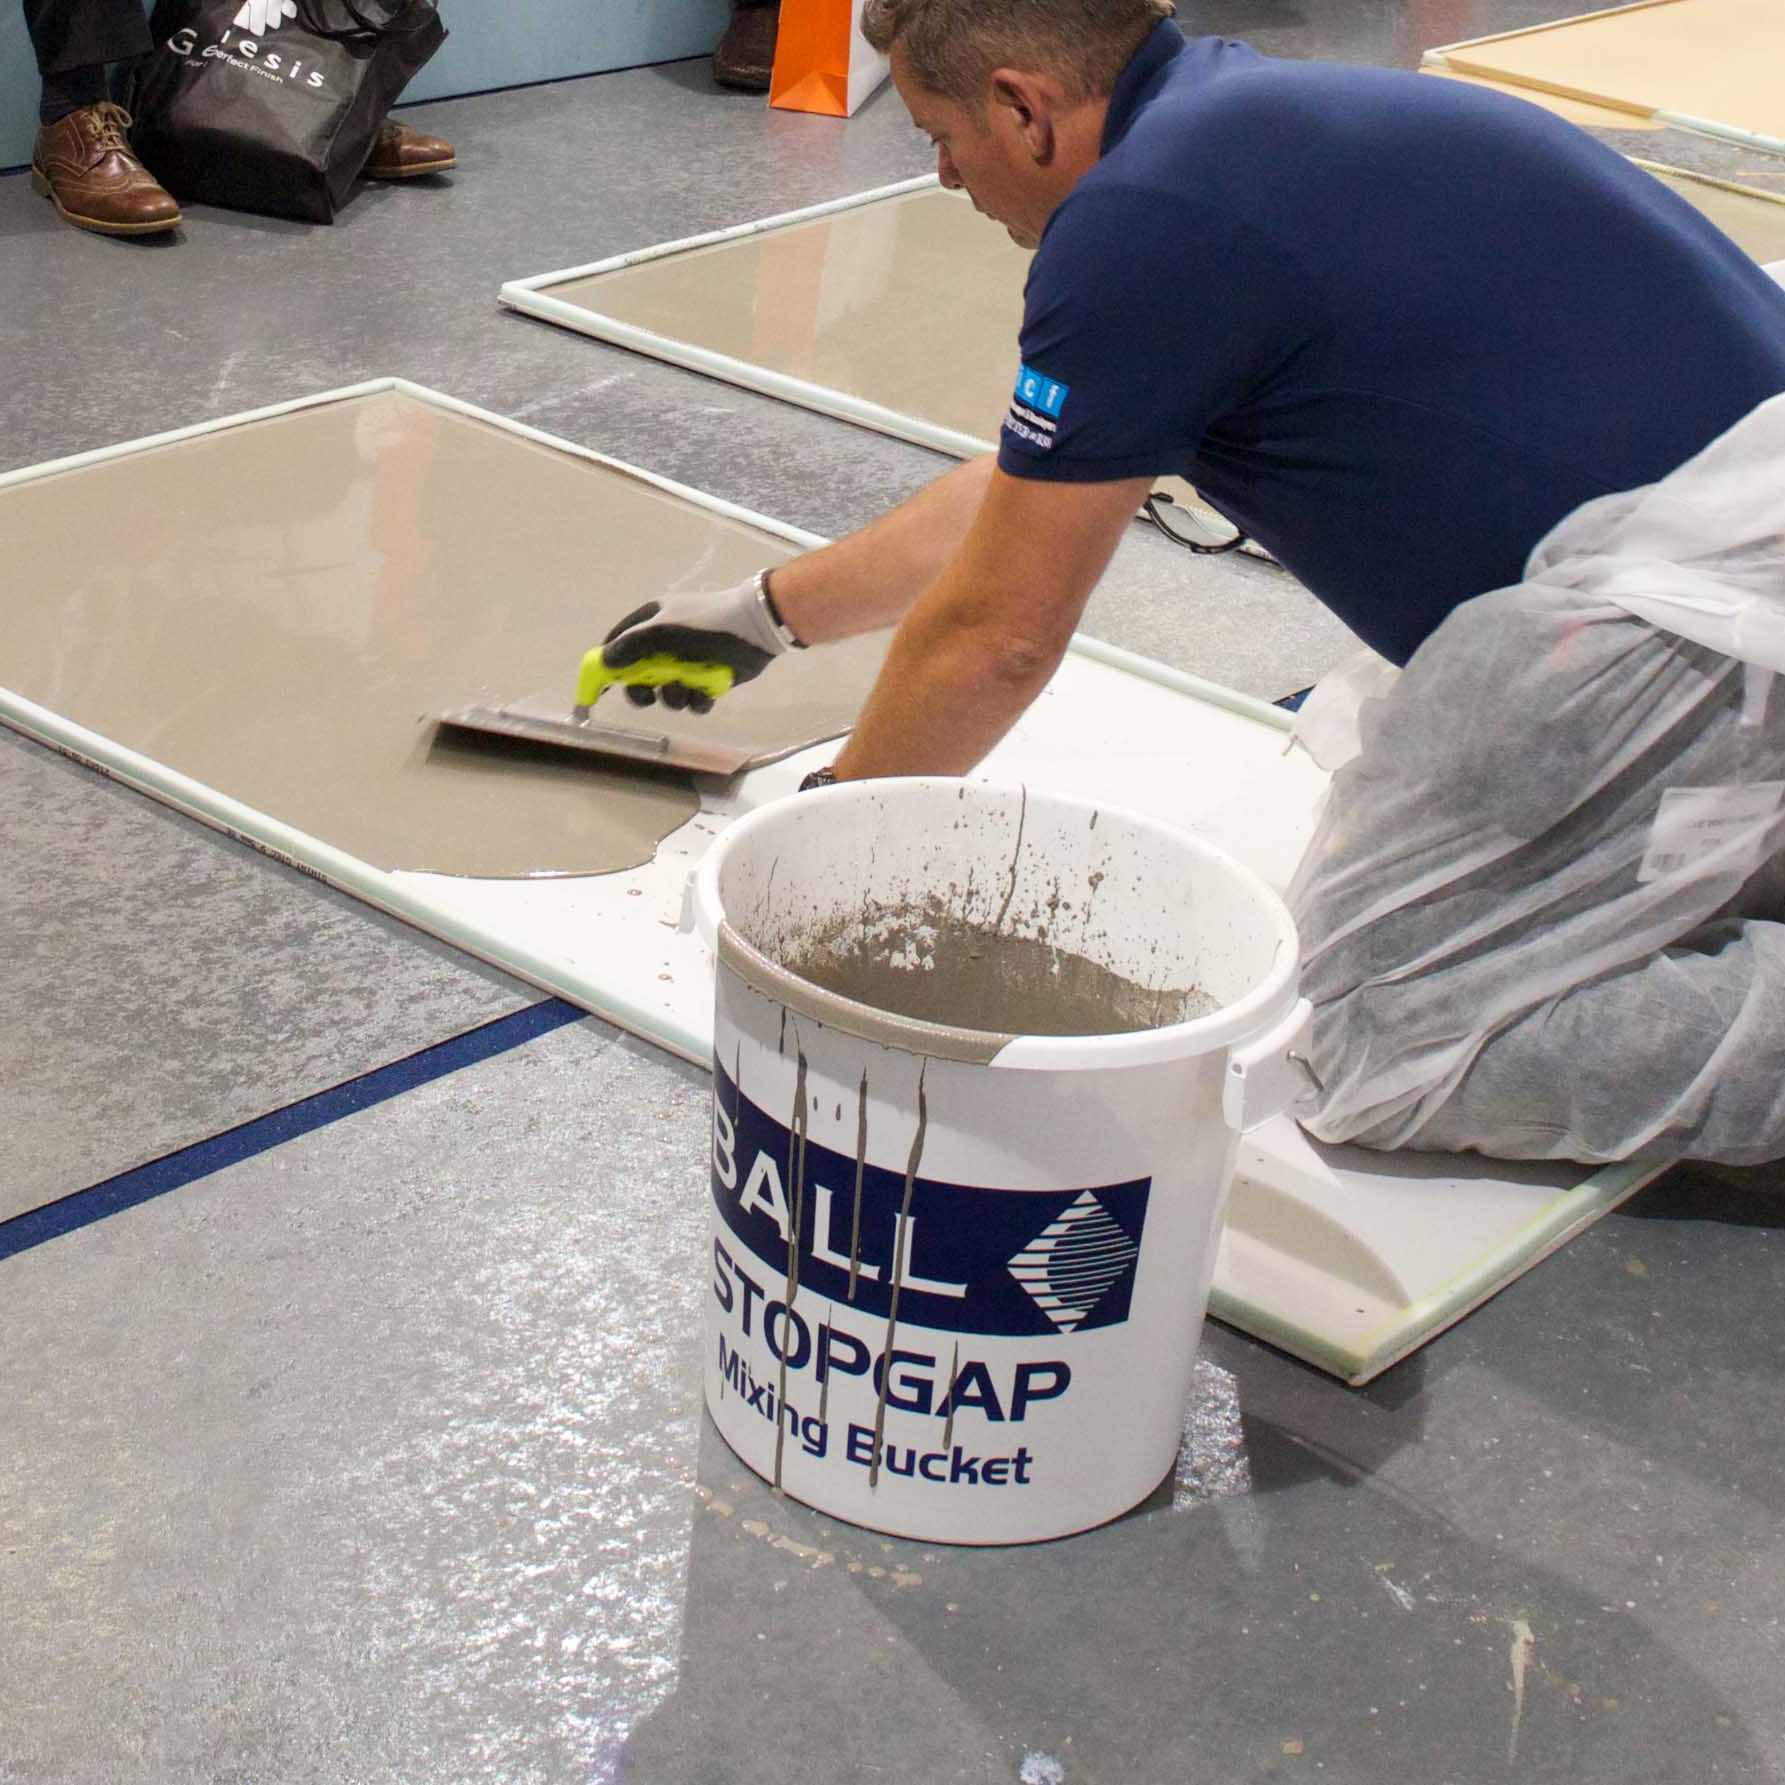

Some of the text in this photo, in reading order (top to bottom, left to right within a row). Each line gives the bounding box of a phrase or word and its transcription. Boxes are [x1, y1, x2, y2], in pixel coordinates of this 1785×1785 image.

[216, 49, 250, 69] erfect
[250, 63, 284, 84] Finish
[715, 1094, 969, 1299] BALL
[713, 1236, 1072, 1423] STOPGAP
[718, 1331, 829, 1458] Mixing
[845, 1422, 1034, 1486] Bucket
